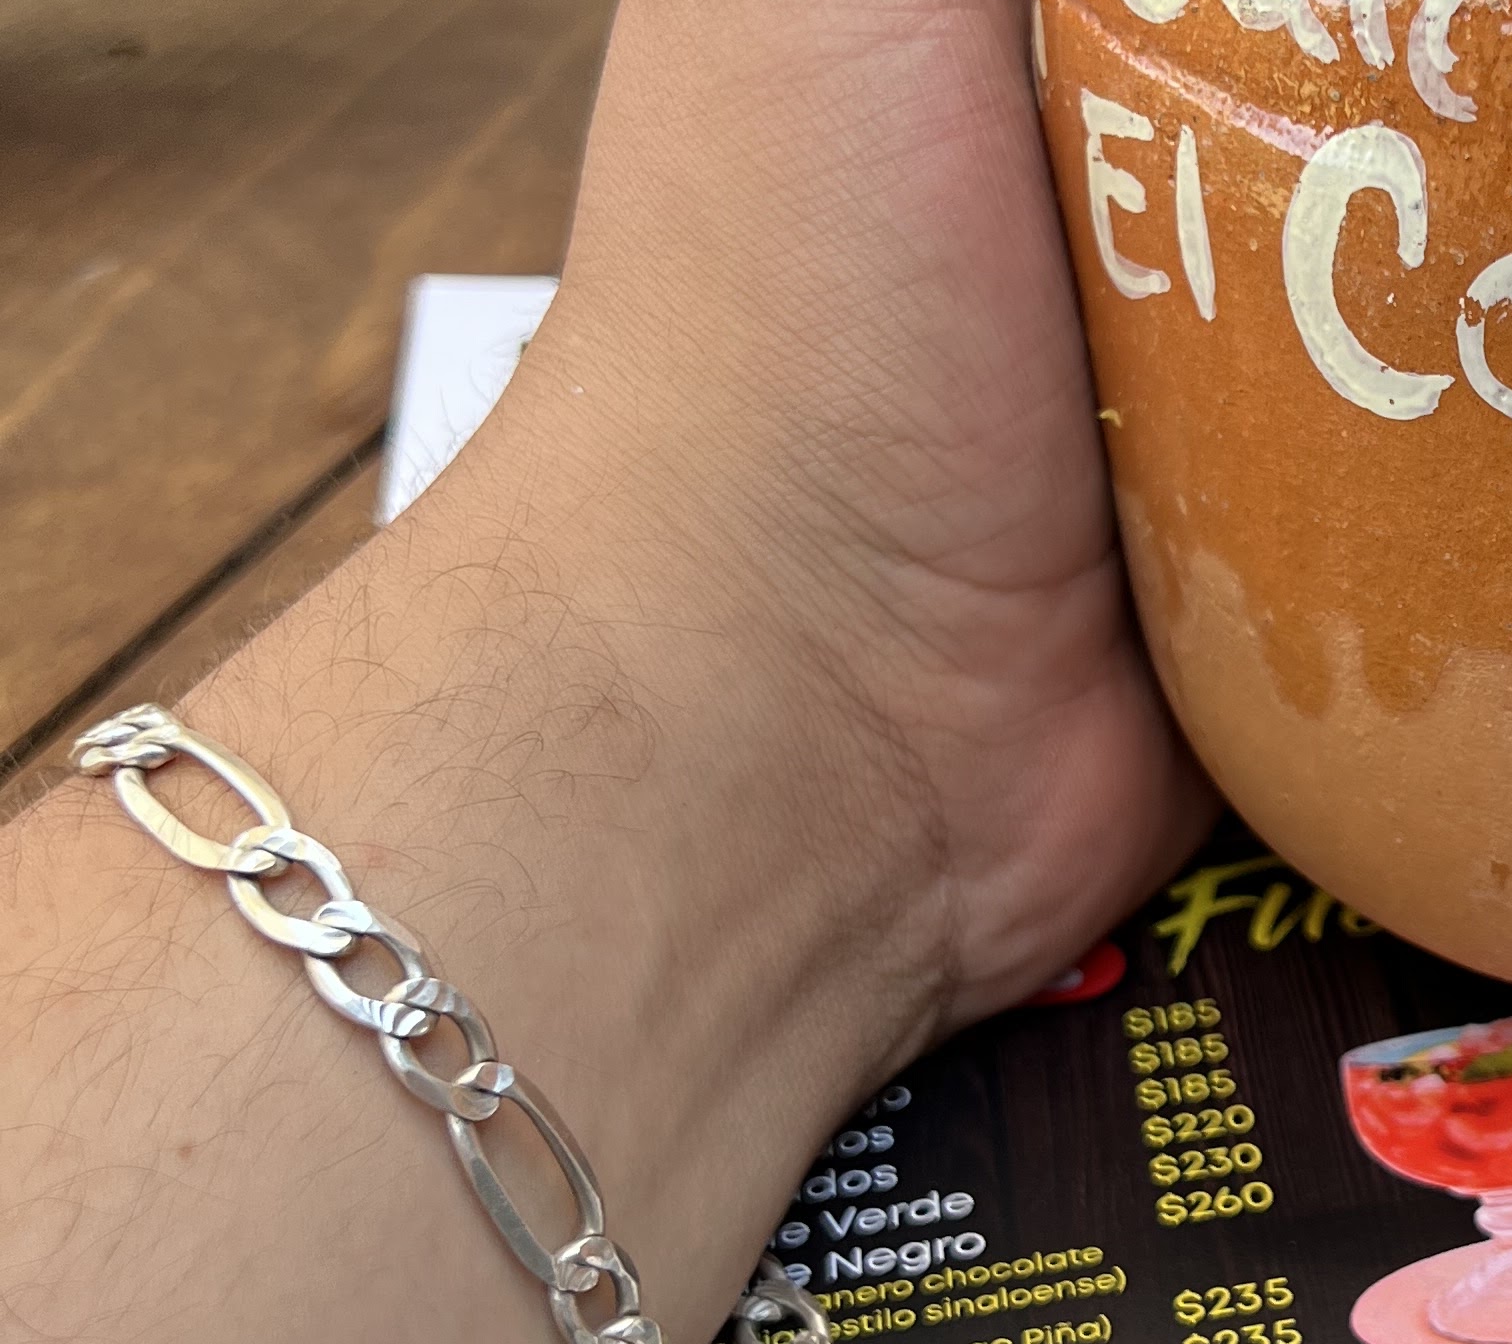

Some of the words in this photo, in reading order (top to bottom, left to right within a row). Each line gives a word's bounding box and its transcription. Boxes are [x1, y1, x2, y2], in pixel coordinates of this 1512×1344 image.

[1080, 88, 1218, 321] El
[800, 1163, 899, 1204] dos
[1141, 1103, 1255, 1149] $220
[819, 1189, 976, 1243] Verde
[1149, 1142, 1263, 1187] $230
[811, 1277, 915, 1312] anero
[919, 1244, 1104, 1295] chocolate
[824, 1230, 987, 1284] Negro
[1155, 1181, 1274, 1229] $260
[923, 1264, 1128, 1325] sinaloense)
[1172, 1277, 1295, 1327] $235
